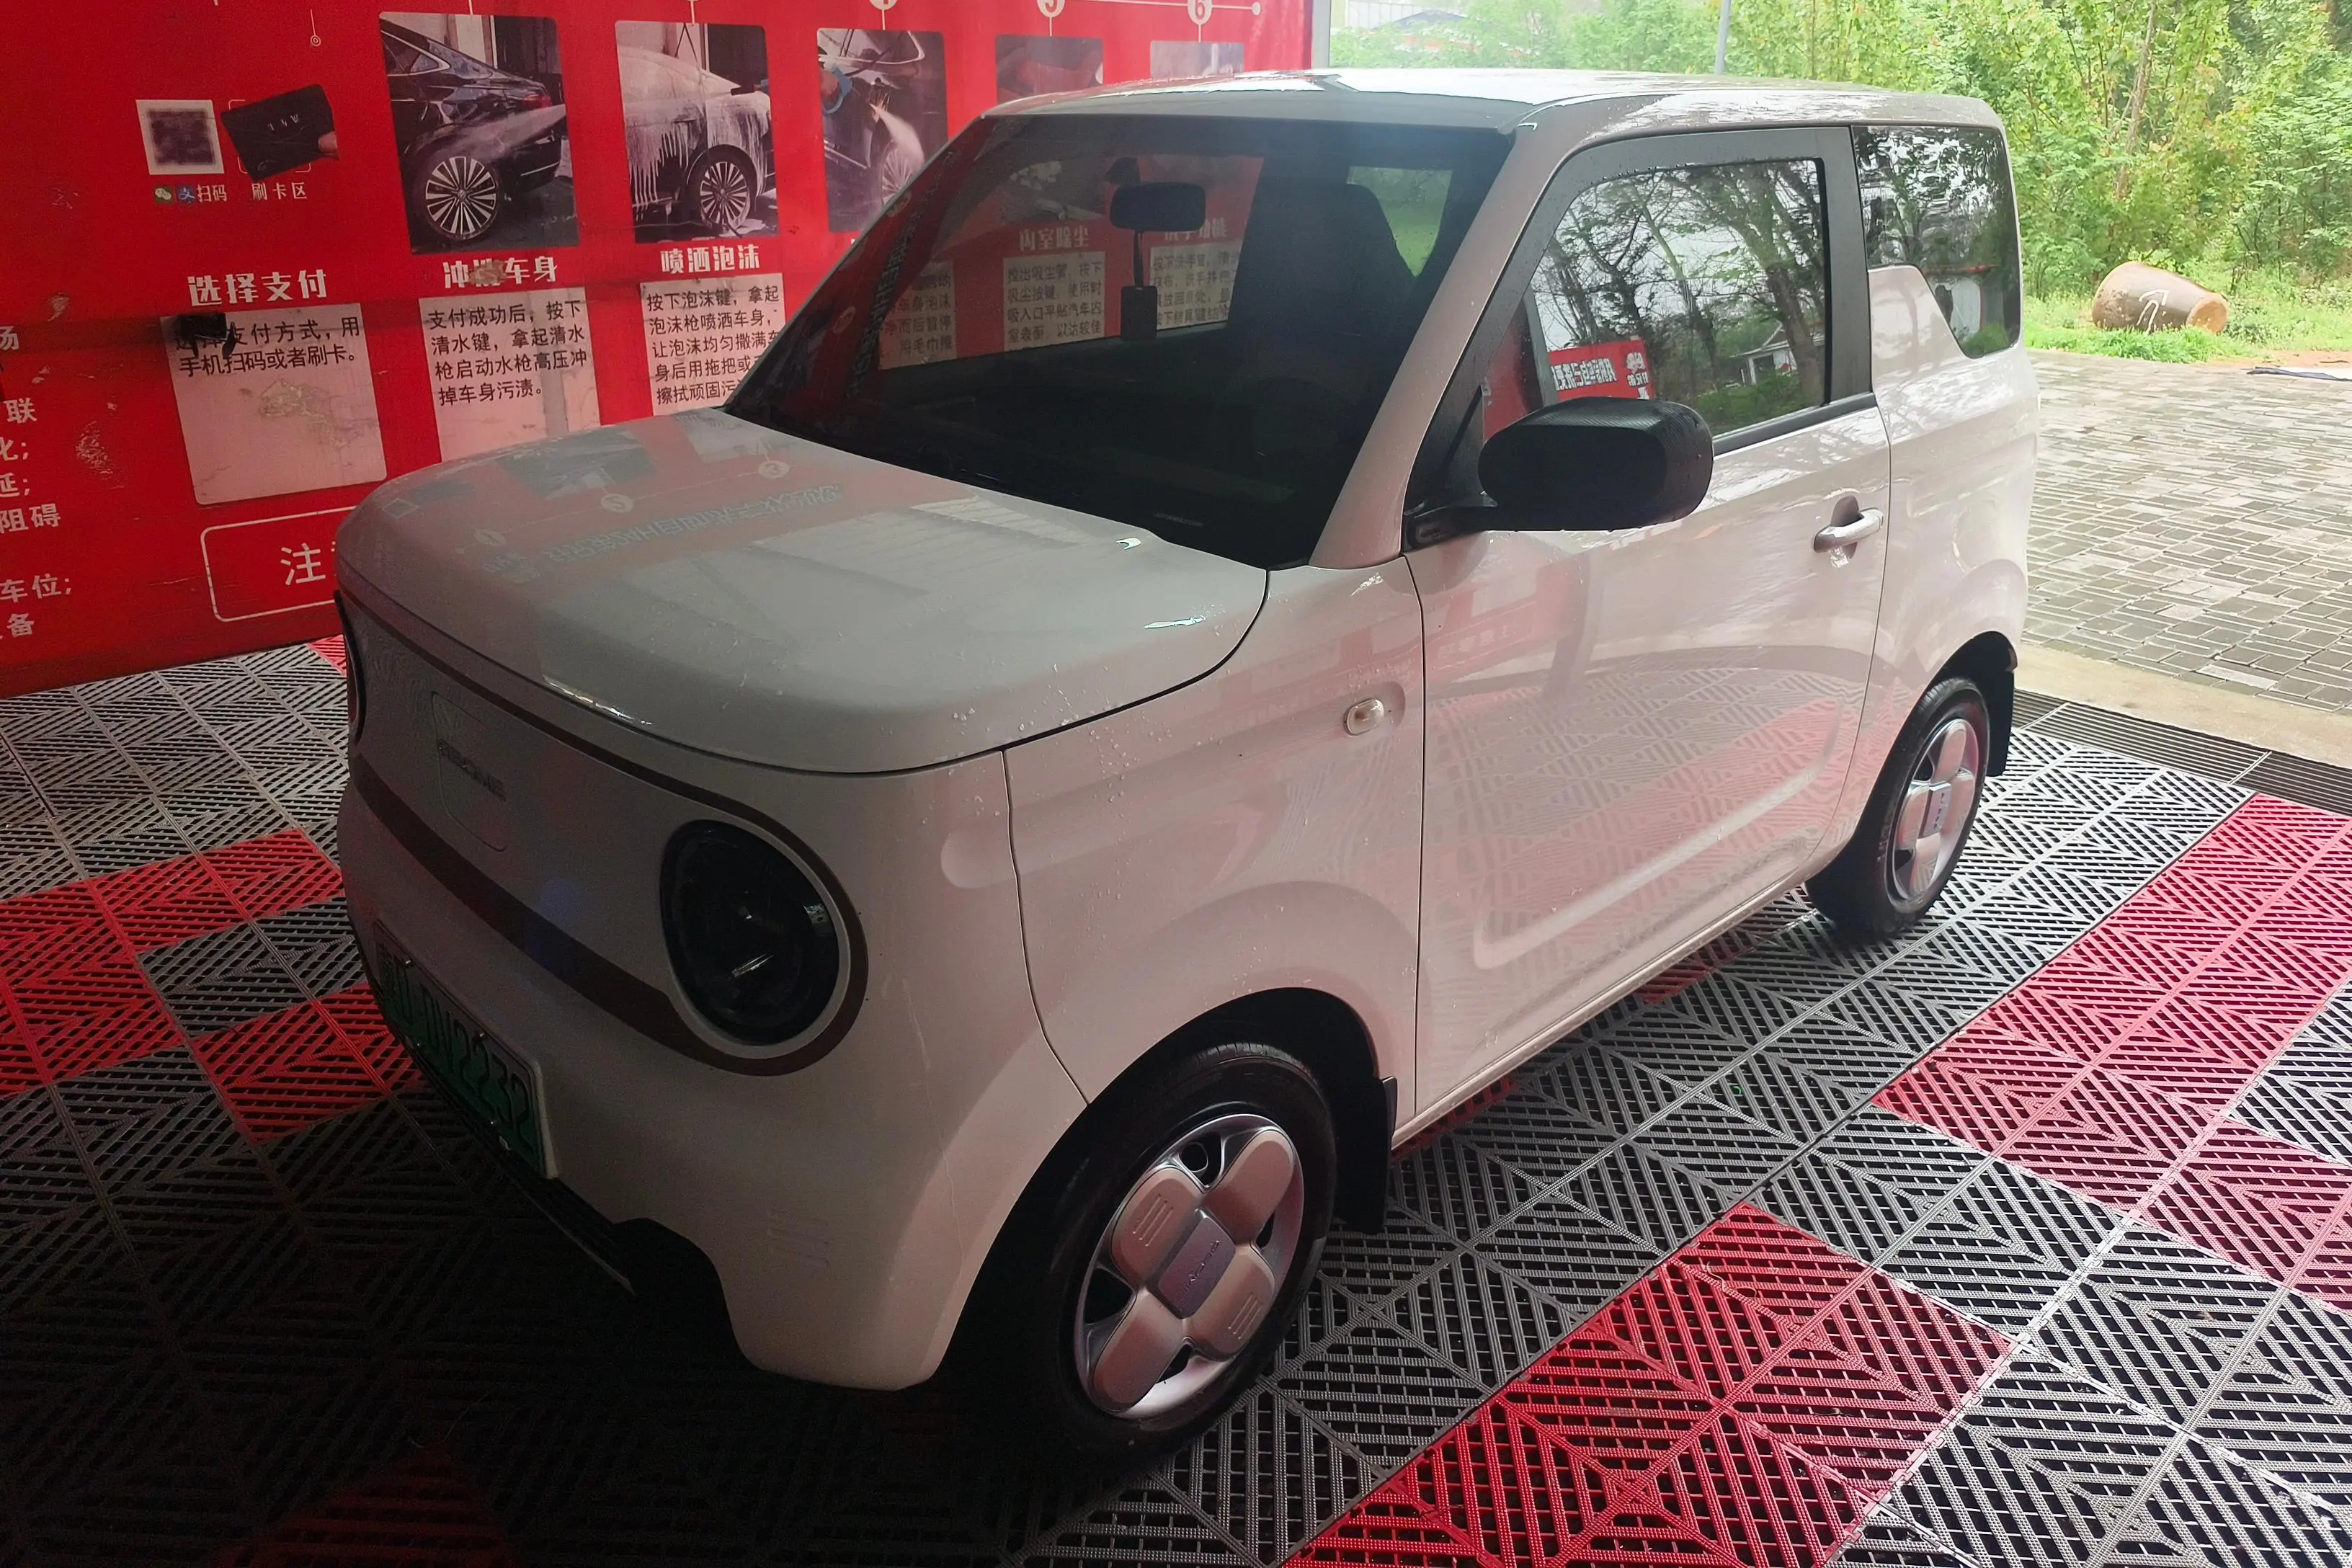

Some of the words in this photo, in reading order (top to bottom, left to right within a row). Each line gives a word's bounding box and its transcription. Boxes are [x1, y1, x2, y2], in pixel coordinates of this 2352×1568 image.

[197, 184, 228, 202] 扫码
[252, 182, 307, 201] 刷卡区
[660, 244, 760, 275] 喷洒泡沫
[187, 269, 327, 307] 选择支付
[175, 317, 360, 350] 支付方式，用
[435, 348, 587, 381] 枪启动水枪高压冲
[654, 355, 761, 383] 身后用拖把或
[438, 378, 542, 407] 掉车身污渍。
[656, 380, 742, 405] 擦拭顽固污
[3, 397, 37, 424] 联
[280, 541, 337, 586] 注
